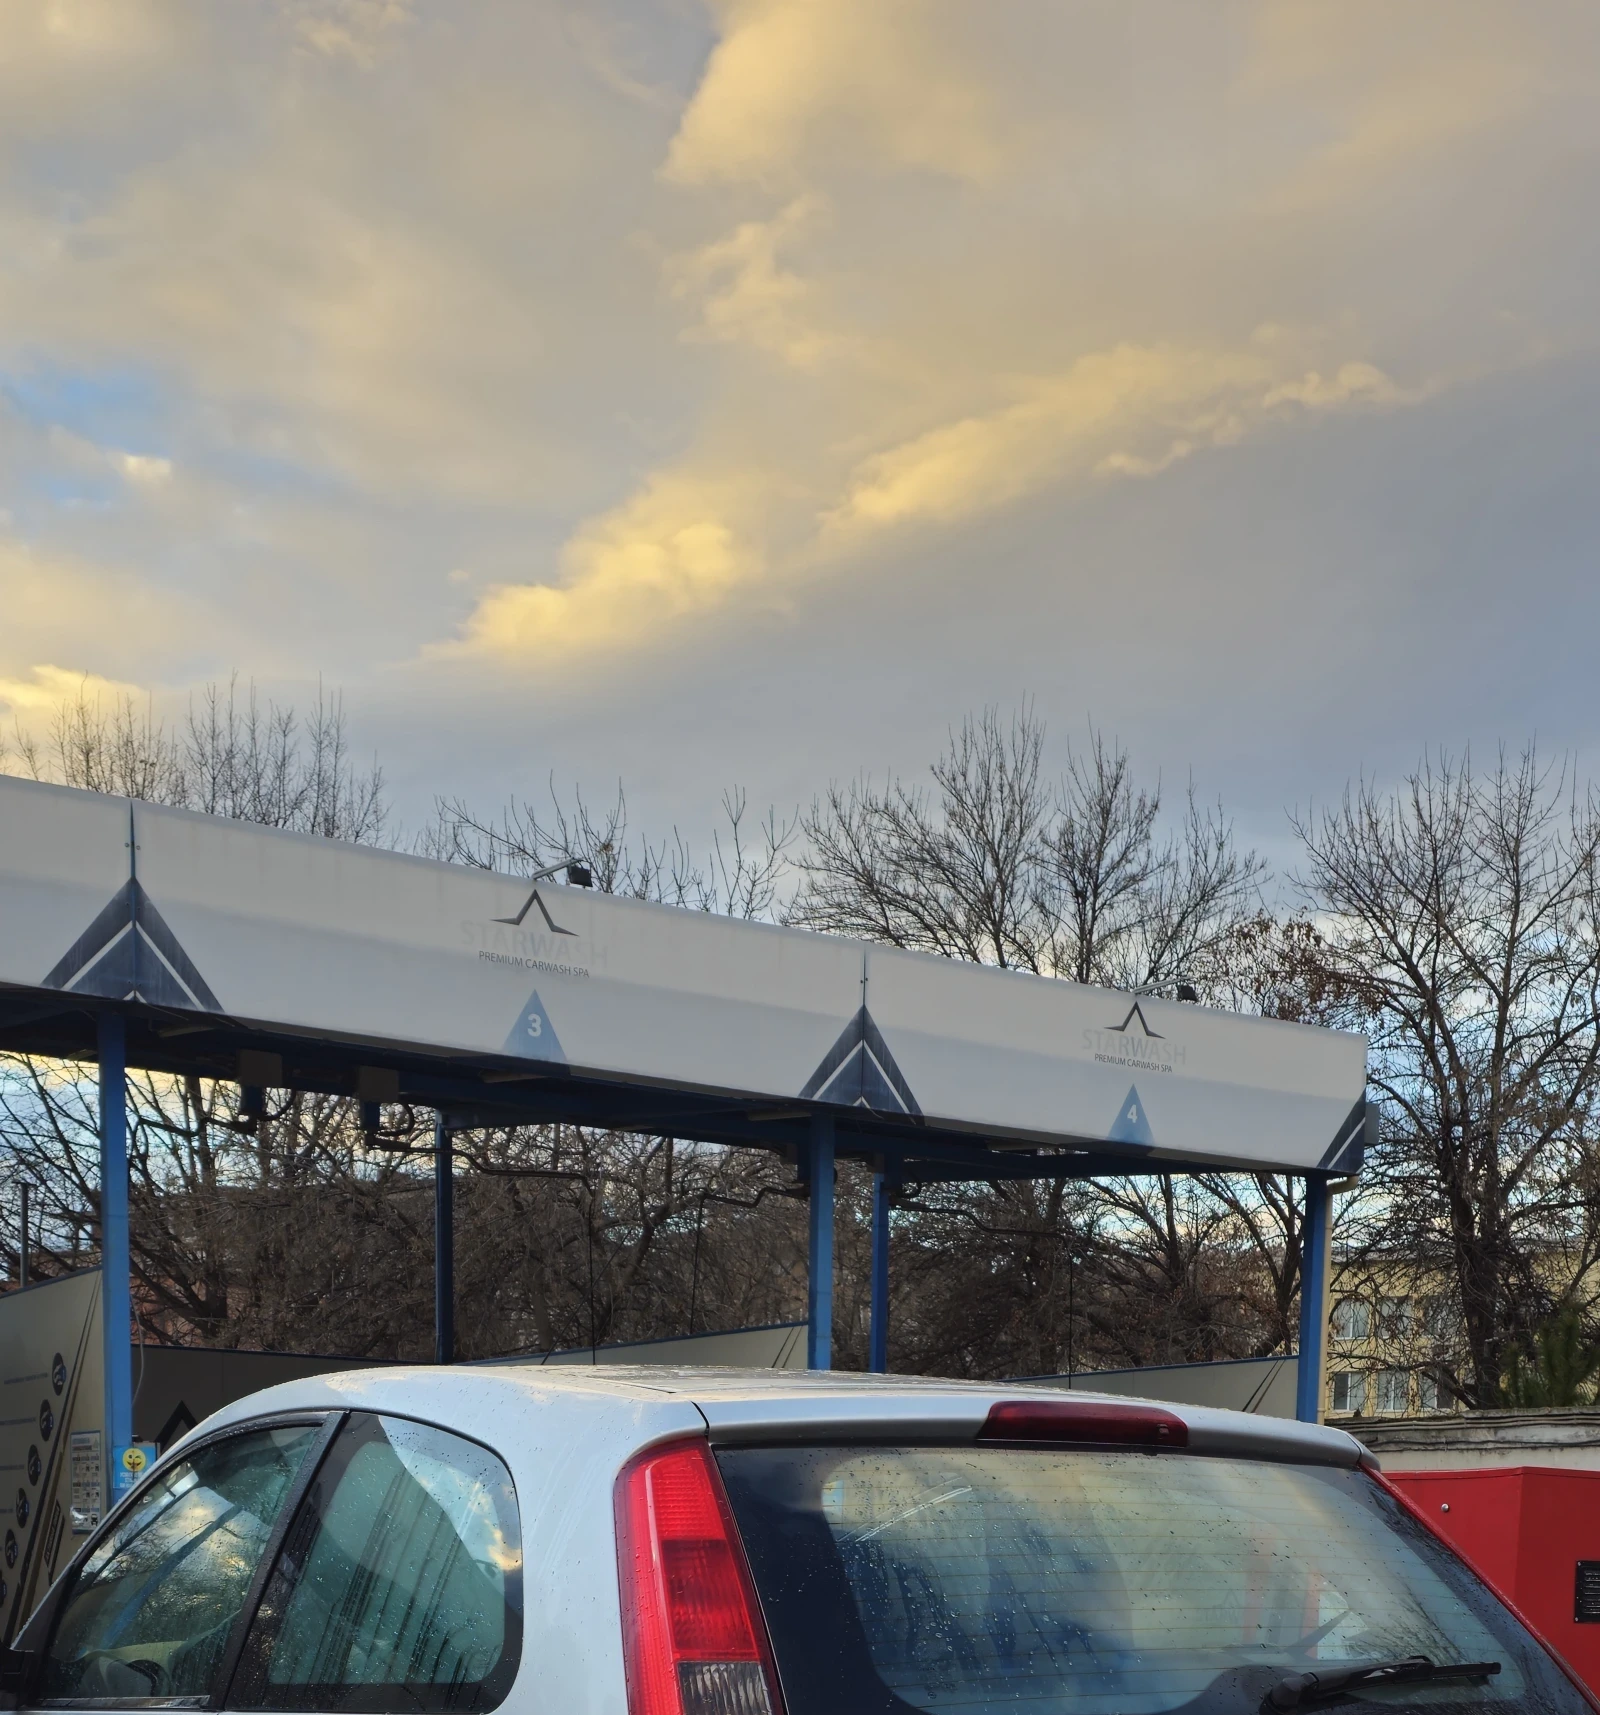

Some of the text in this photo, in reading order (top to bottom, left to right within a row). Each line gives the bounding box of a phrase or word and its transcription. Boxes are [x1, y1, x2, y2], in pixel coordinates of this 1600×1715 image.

[460, 920, 608, 967] STARWASH
[478, 950, 589, 978] PREMIUM CARWASH SPA
[527, 1013, 542, 1037] 3
[1082, 1029, 1186, 1064] STARWASH
[1094, 1053, 1172, 1073] PREMIUM CARWASH SPA
[1127, 1104, 1138, 1124] 4
